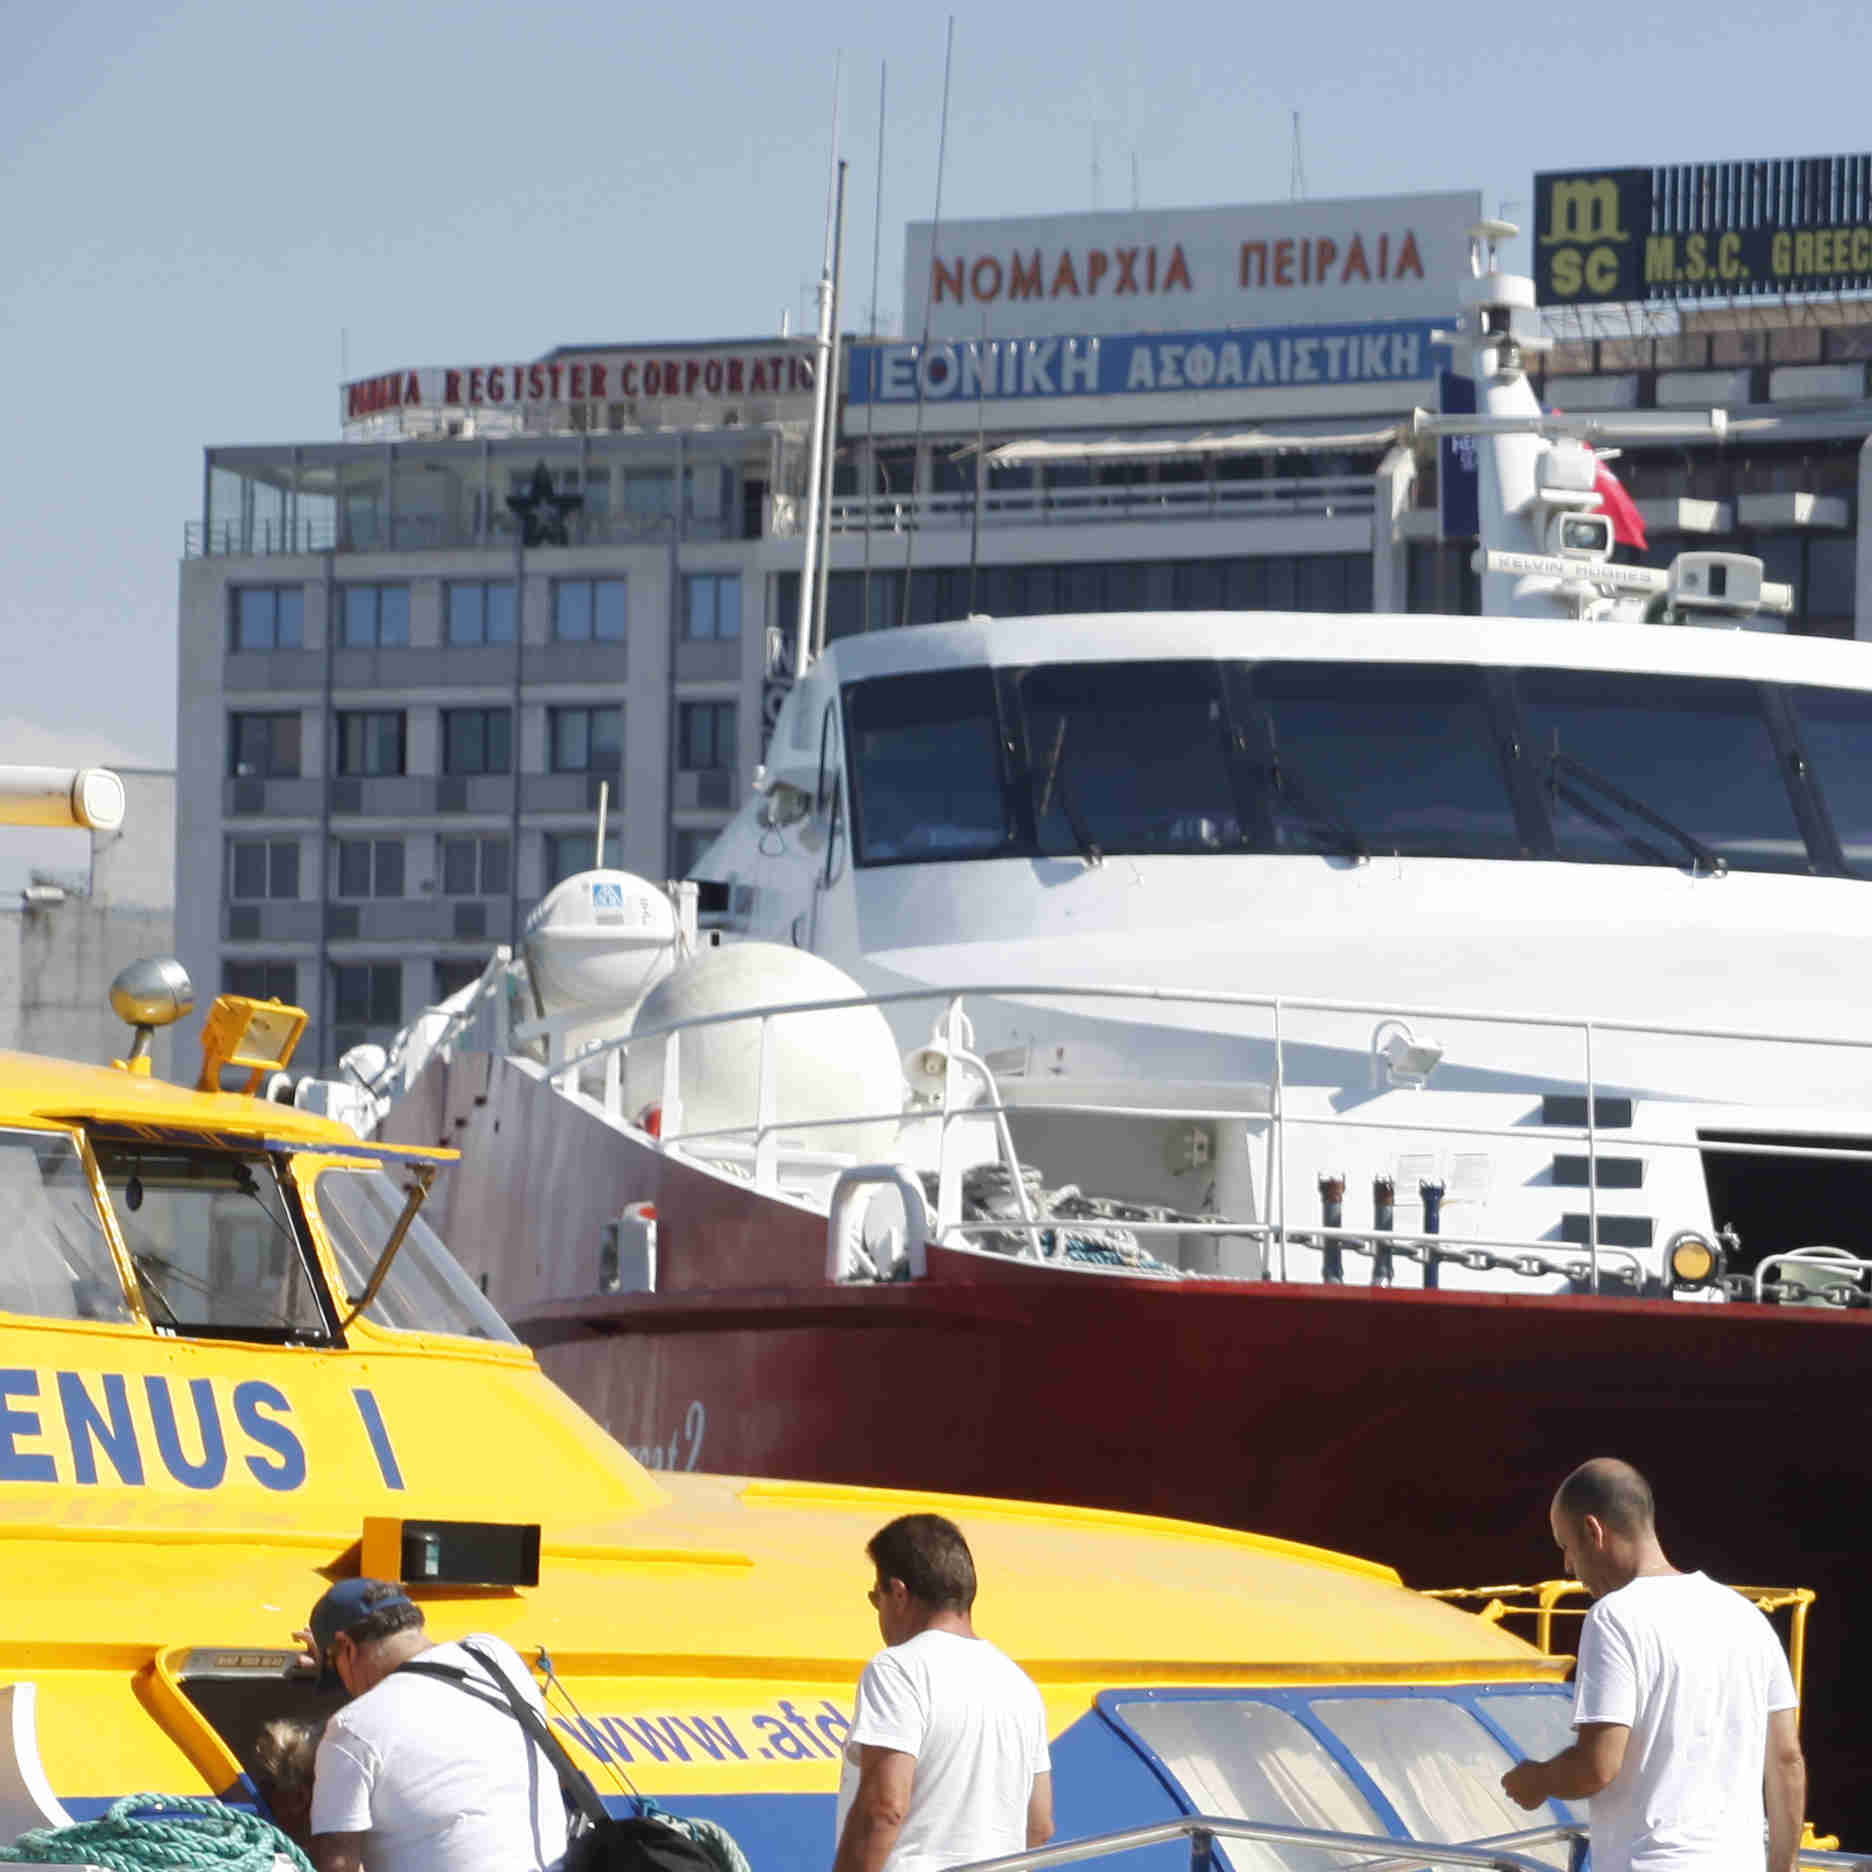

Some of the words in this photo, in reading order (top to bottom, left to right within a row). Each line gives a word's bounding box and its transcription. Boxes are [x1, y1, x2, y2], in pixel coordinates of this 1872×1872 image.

[930, 243, 1193, 303] ΝΟΜΑΡΧΙΑ
[1238, 229, 1426, 288] ΠΕΙΡΑΙΑ
[1644, 233, 1750, 282] M.S.C.
[444, 361, 607, 404] REGISTER
[1498, 556, 1563, 573] KELVIN
[0, 1369, 308, 1491] ENUS
